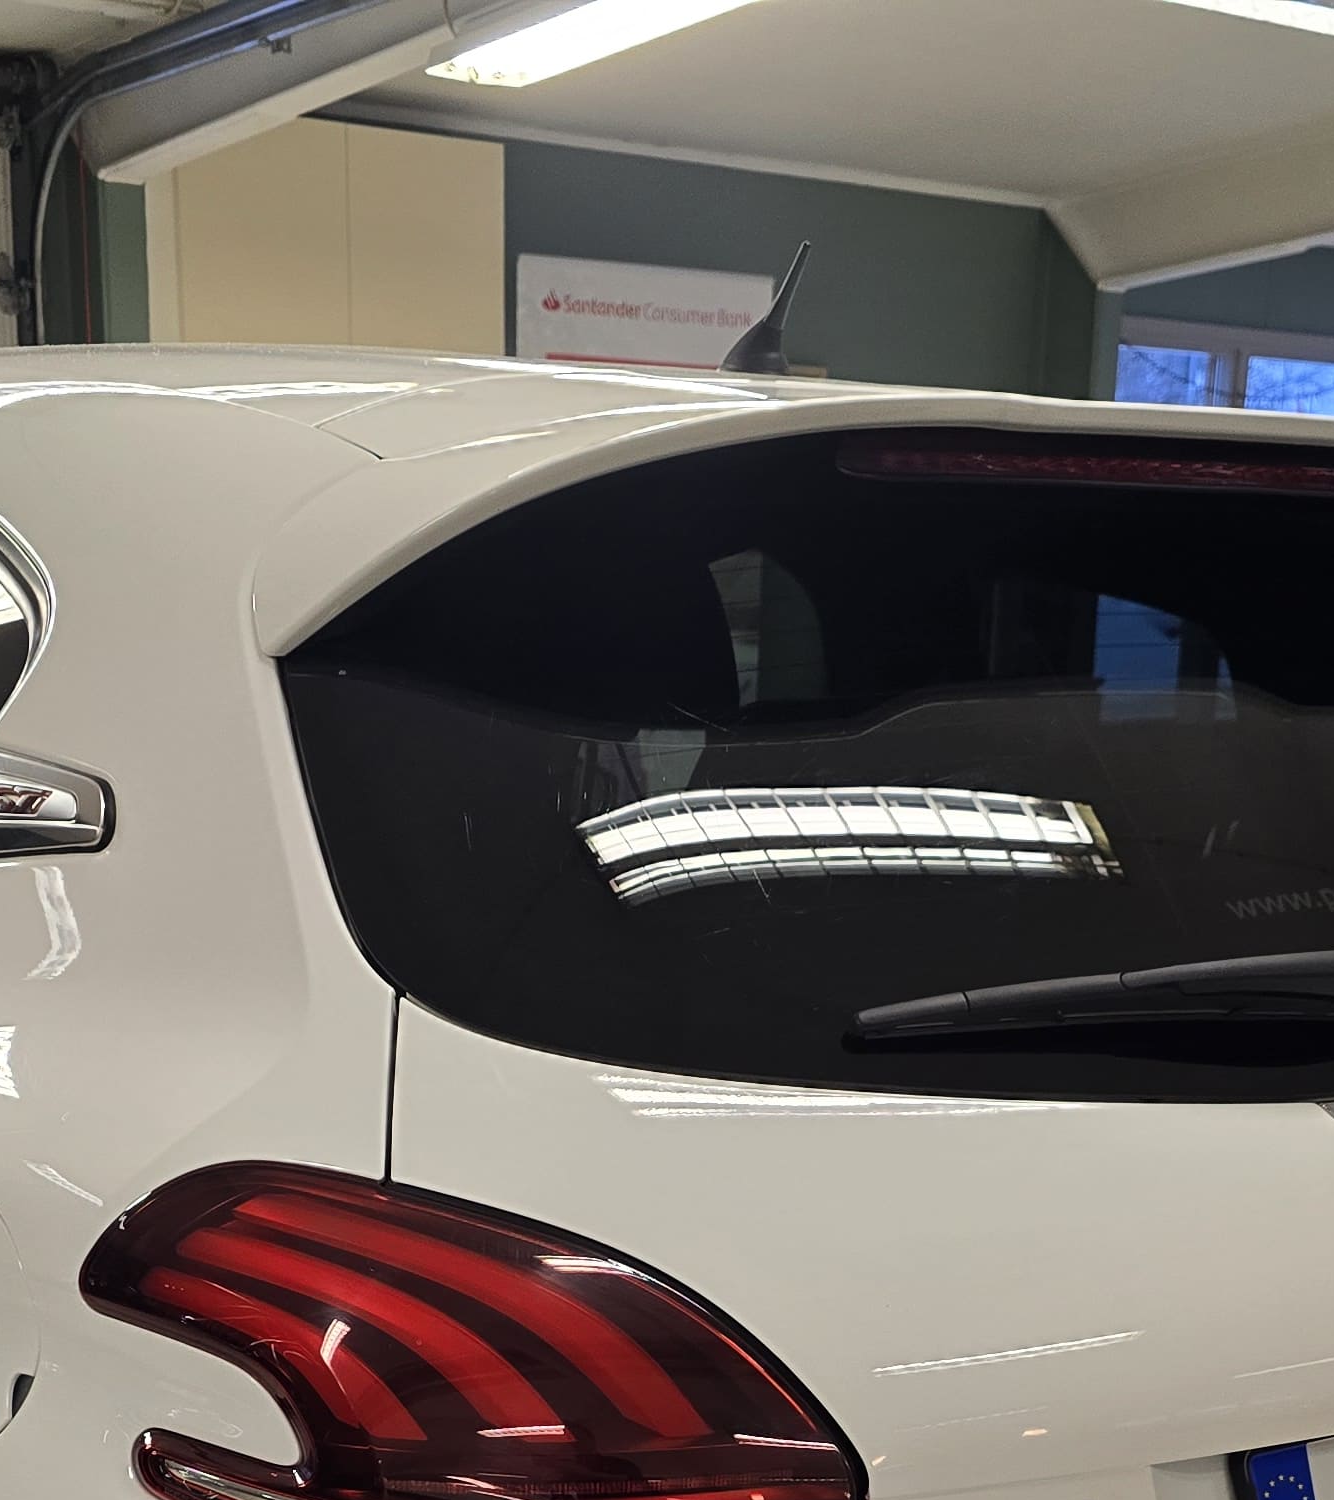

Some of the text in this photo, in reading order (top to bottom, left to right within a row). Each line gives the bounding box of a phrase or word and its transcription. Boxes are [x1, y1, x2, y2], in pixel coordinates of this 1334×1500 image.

[562, 294, 753, 329] Santander Consumer Bank
